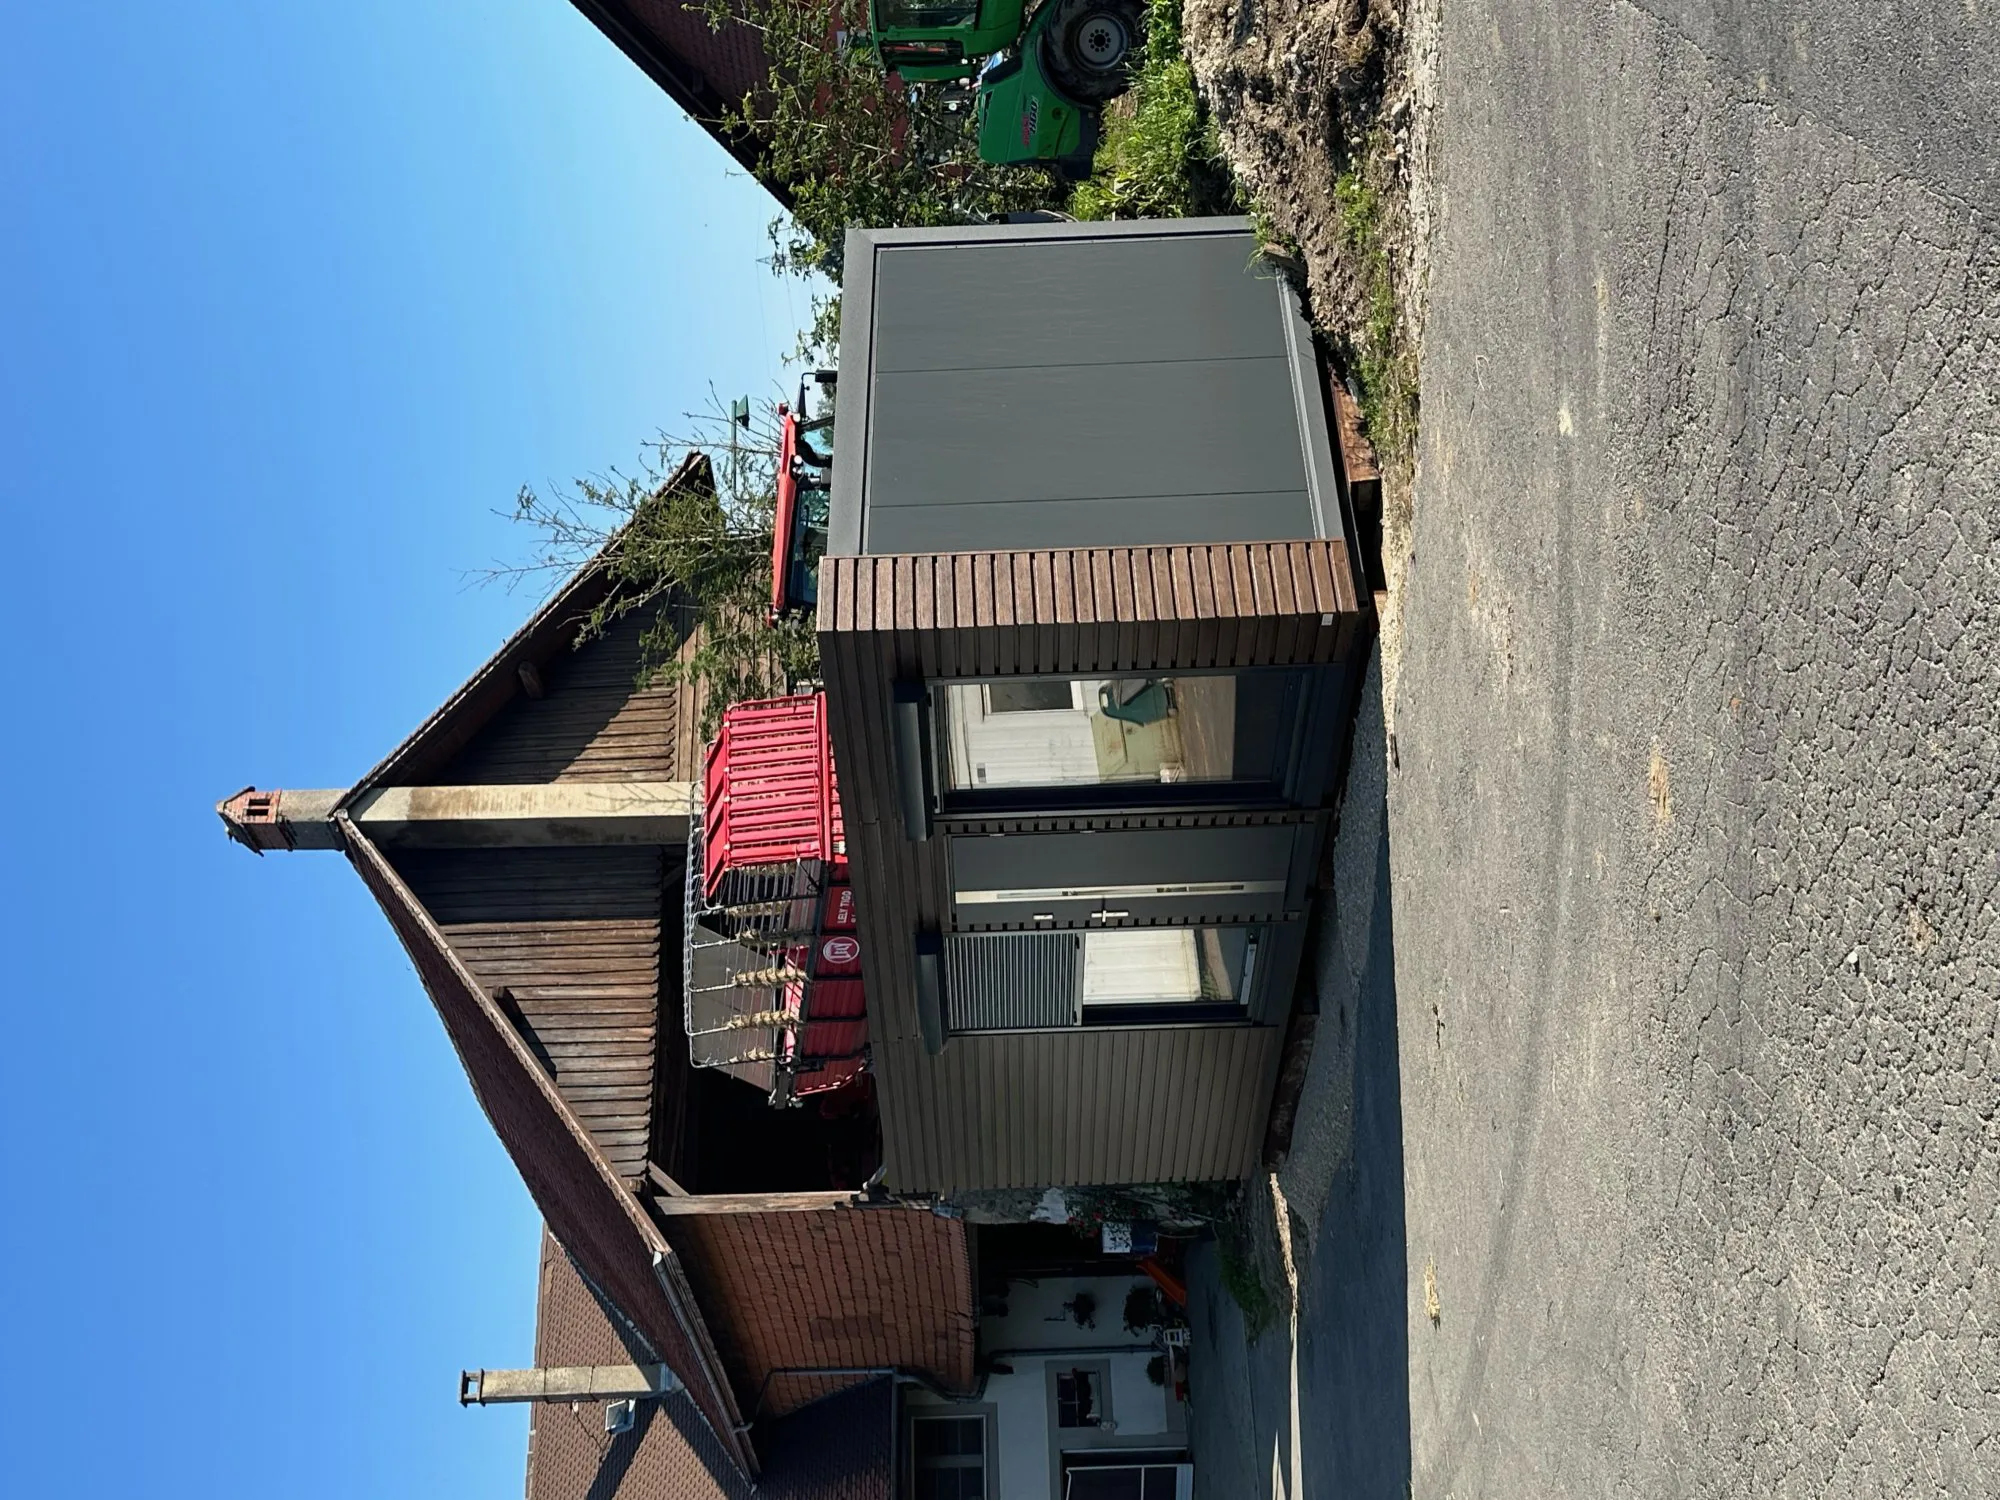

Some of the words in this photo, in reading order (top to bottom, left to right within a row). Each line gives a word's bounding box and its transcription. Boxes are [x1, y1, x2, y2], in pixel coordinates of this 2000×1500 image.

[839, 890, 851, 907] TIGO
[837, 908, 848, 924] LELY
[830, 942, 853, 959] LELY
